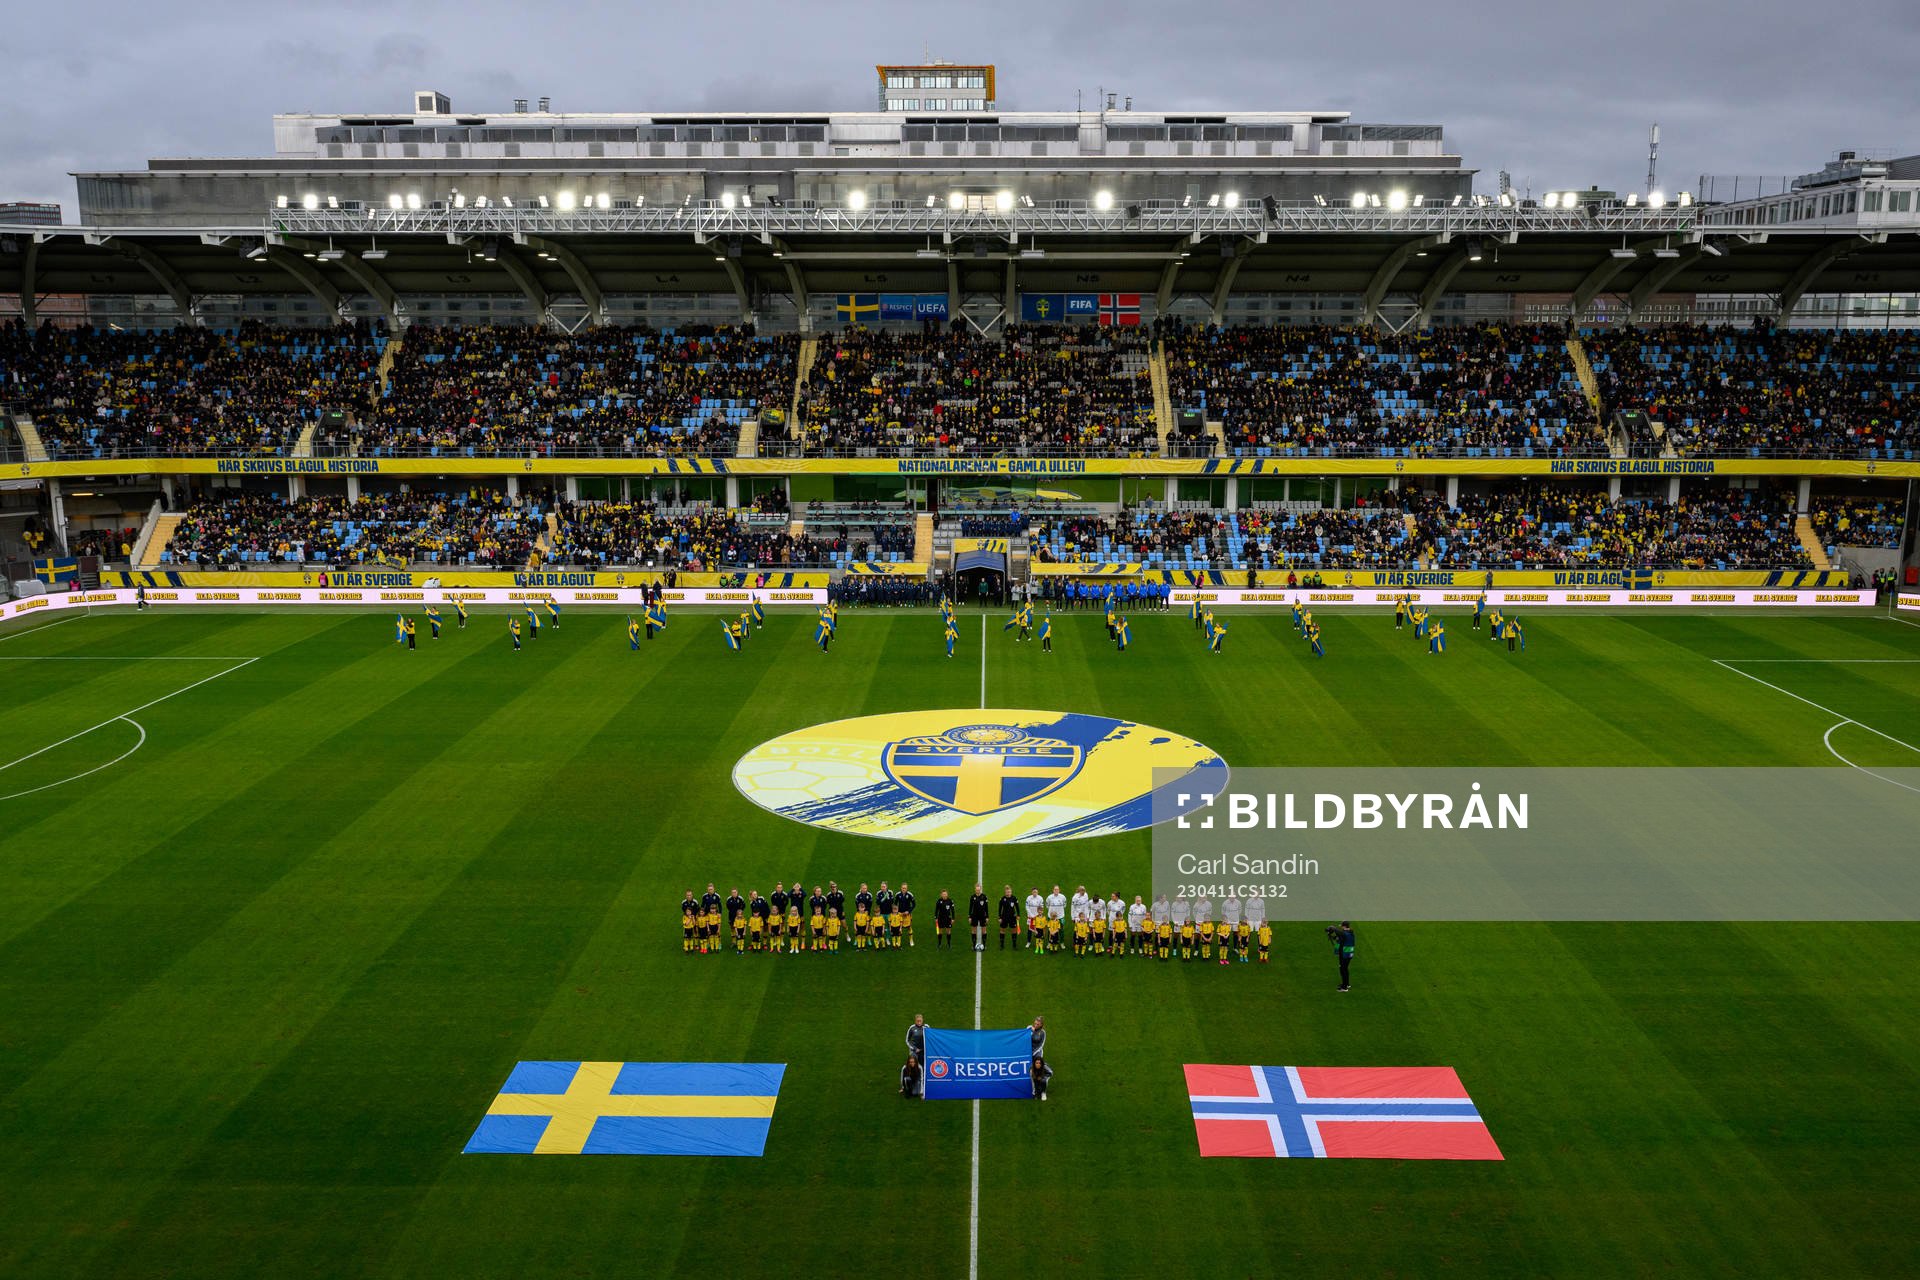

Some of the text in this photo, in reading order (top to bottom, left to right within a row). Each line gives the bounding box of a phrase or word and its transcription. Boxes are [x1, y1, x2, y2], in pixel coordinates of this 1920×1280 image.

[889, 304, 913, 312] RESPECT
[918, 303, 946, 313] UEFA
[1070, 300, 1092, 310] FIFA
[217, 460, 379, 473] HÄR SKRIVS BLÅGUL HISTORIA
[898, 460, 998, 473] NATIONALARENAN
[1008, 460, 1046, 473] GAMLA
[1049, 460, 1085, 473] ULLEVI
[1551, 461, 1714, 473] HÄR SKRIVS BLÅGUL HISTORIA
[332, 573, 412, 586] VI ÄR SVERIGE
[528, 573, 543, 586] ÄR
[546, 573, 595, 586] BLÅGULT
[1374, 572, 1454, 585] VI ÄR SVERIGE
[1554, 573, 1566, 585] VI
[1568, 572, 1584, 585] ÄR
[87, 593, 117, 602] SVERIGE
[152, 592, 178, 601] SVERIGE
[213, 592, 240, 601] SVERIGE
[275, 592, 301, 601] SVERIGE
[336, 592, 362, 601] SVERIGE
[397, 592, 424, 601] SVERIGE
[459, 592, 485, 601] SVERIGE
[525, 592, 552, 601] SVERIGE
[591, 592, 618, 601] SVERIGE
[722, 592, 749, 601] SVERIGE
[787, 592, 813, 601] SVERIGE
[1258, 593, 1285, 602] SVERIGE
[1327, 593, 1354, 602] SVERIGE
[1521, 593, 1548, 602] SVERIGE
[1584, 593, 1610, 602] SVERIGE
[1646, 593, 1673, 602] SVERIGE
[1708, 593, 1735, 602] SVERIGE
[1770, 593, 1797, 602] SVERIGE
[1833, 593, 1860, 602] SVERIGE
[915, 746, 1053, 754] SVERIGE
[955, 1060, 1030, 1077] RESPECT
